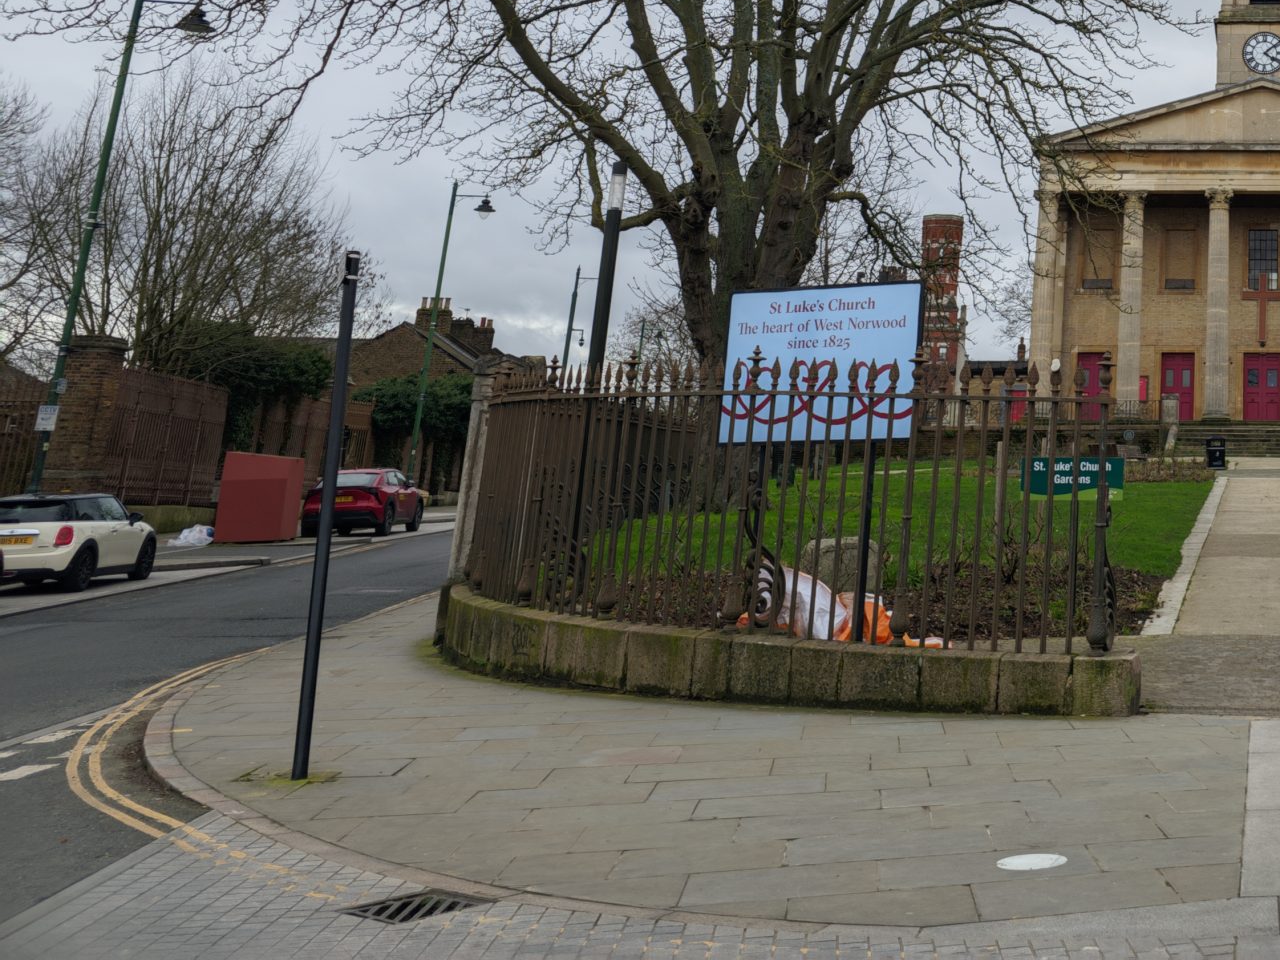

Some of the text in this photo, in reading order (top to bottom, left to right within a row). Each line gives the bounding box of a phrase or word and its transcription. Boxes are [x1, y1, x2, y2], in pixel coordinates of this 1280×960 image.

[769, 296, 876, 314] St Luke's Church
[737, 315, 907, 336] The heart of West Norwood
[787, 334, 850, 351] since 1825
[1033, 461, 1046, 472] St.
